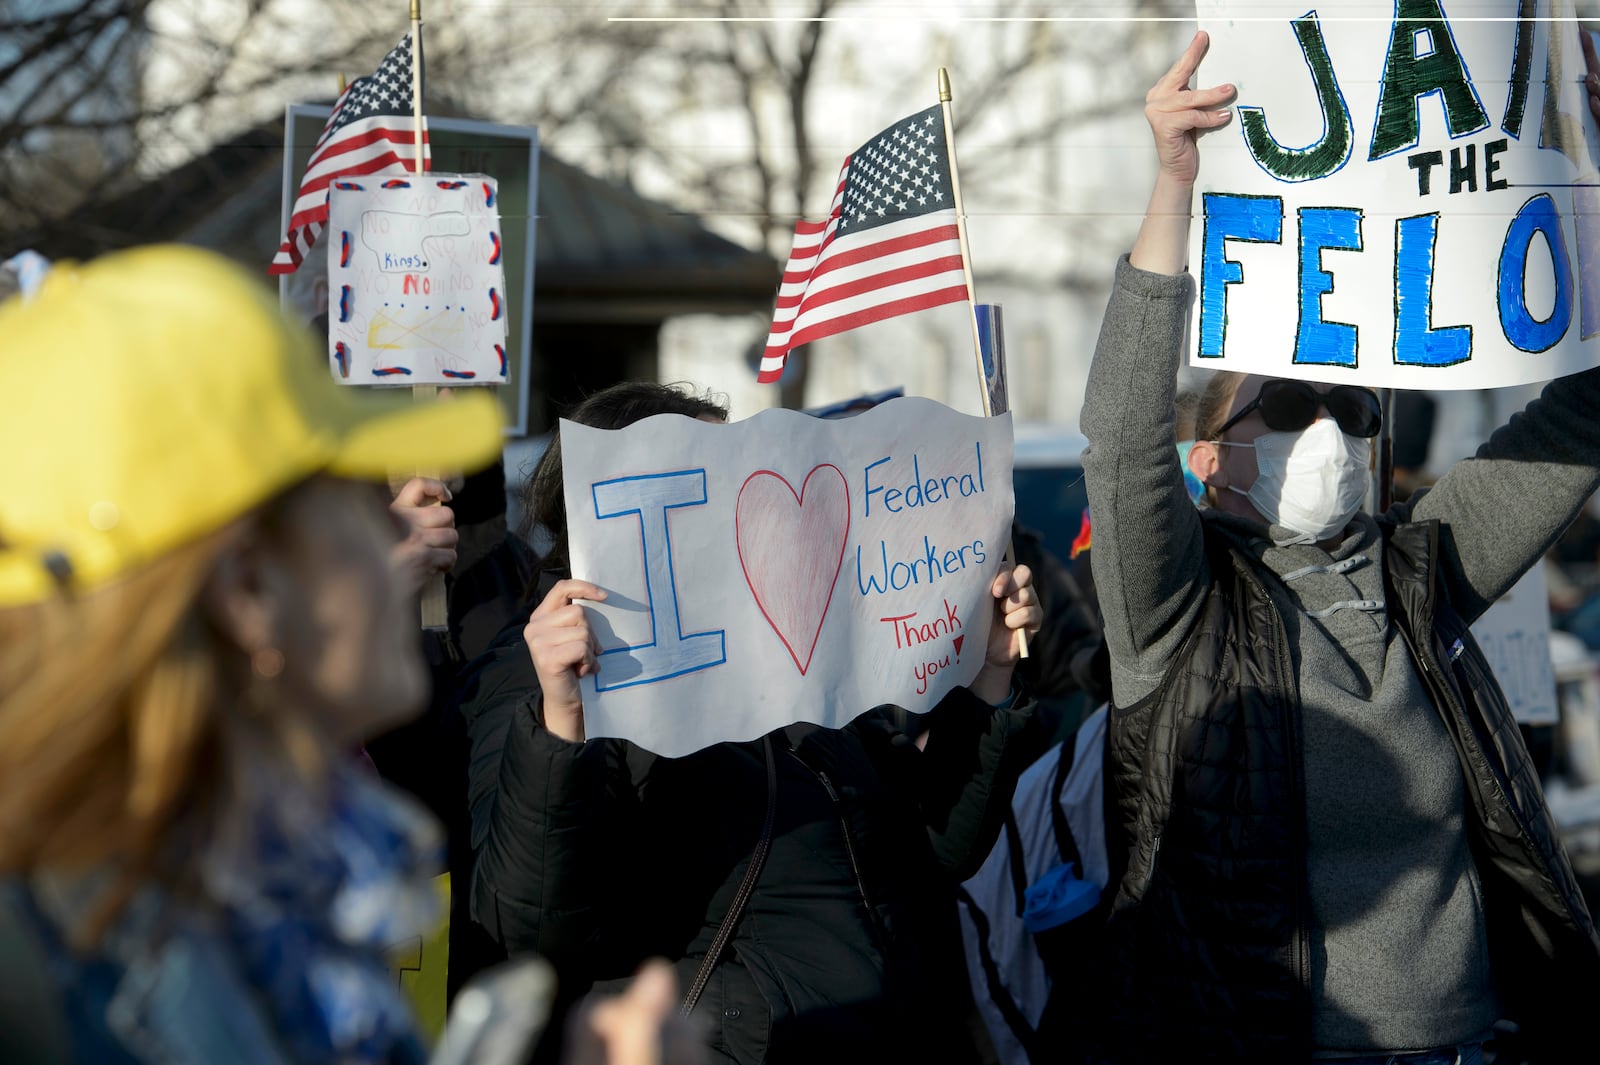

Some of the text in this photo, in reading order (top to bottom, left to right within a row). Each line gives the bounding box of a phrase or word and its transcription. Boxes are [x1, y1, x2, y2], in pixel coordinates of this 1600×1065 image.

[1407, 138, 1508, 196] THE
[864, 441, 986, 518] Federal
[591, 468, 727, 694] I
[856, 536, 987, 597] Workers
[880, 599, 963, 650] Thank
[914, 634, 965, 695] you!
